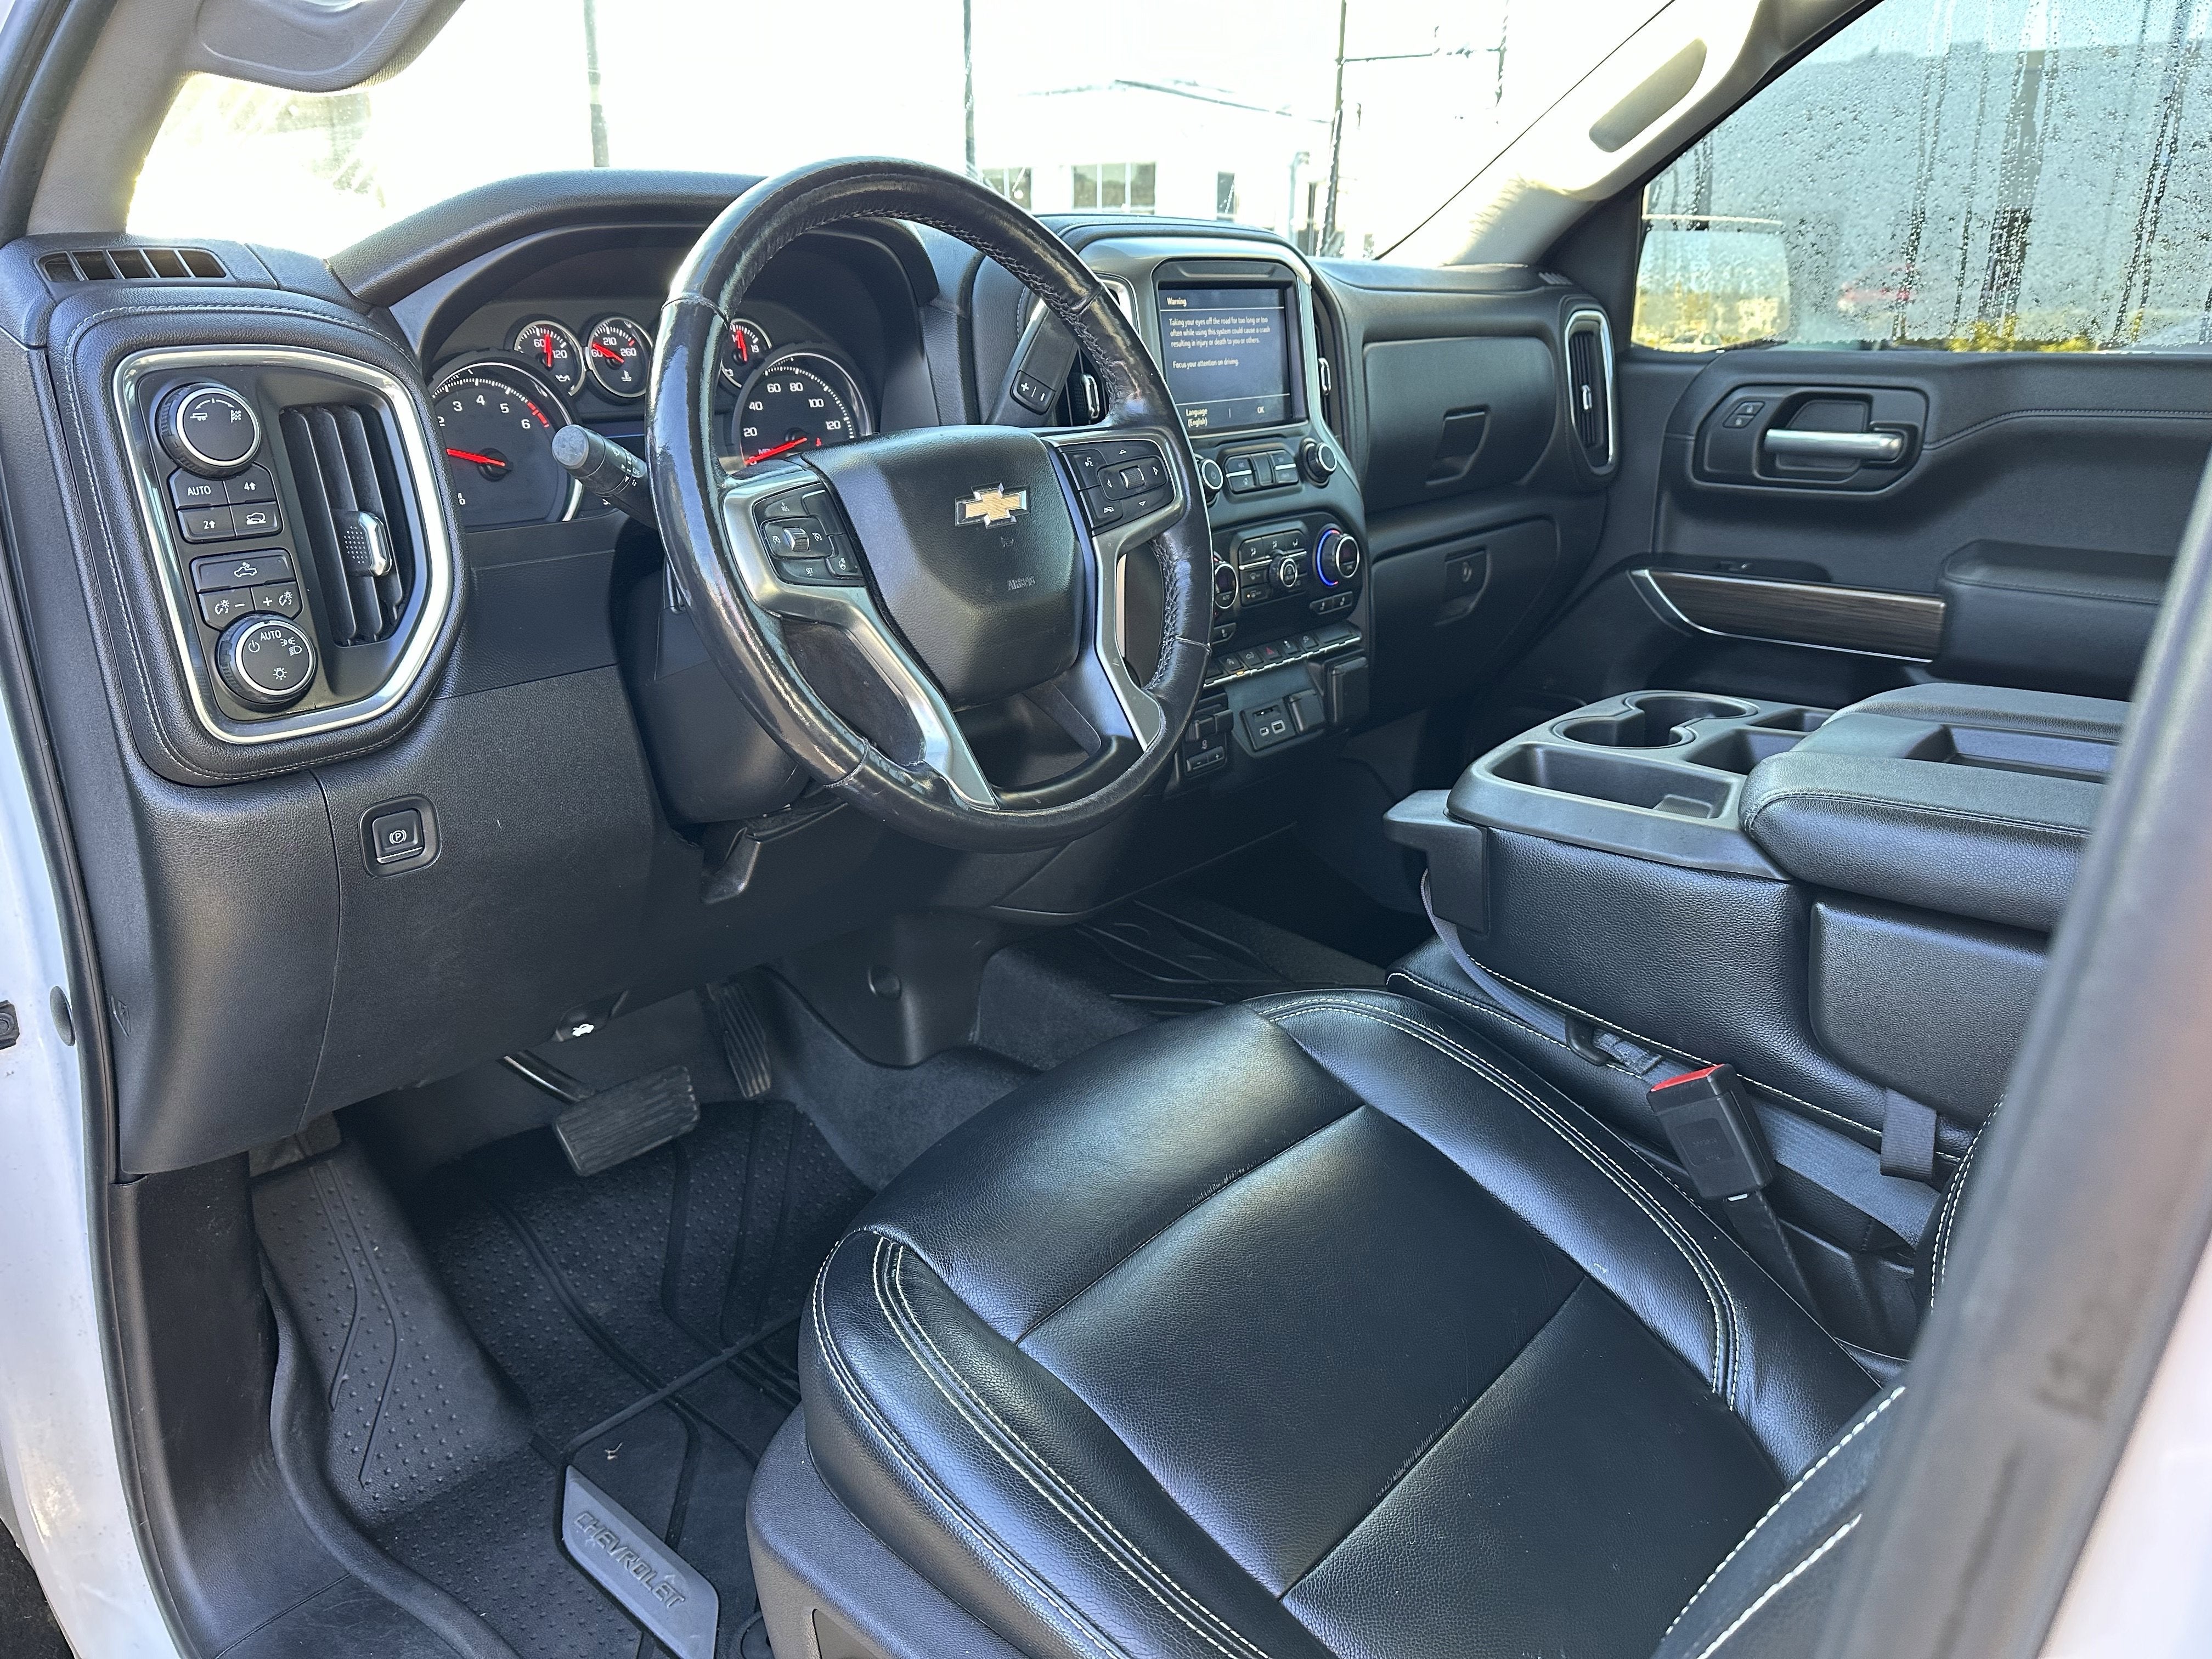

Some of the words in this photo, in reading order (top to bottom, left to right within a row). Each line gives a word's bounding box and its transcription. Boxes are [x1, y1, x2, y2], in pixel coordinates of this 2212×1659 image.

[1166, 297, 1187, 307] Warning
[1169, 318, 1184, 328] Taking
[1246, 316, 1255, 325] long
[1170, 329, 1182, 337] often
[1195, 328, 1207, 337] using
[1216, 328, 1231, 337] system
[533, 339, 545, 348] 60
[603, 337, 617, 346] 210
[1171, 339, 1191, 348] resulting
[1196, 339, 1208, 348] injury
[1245, 336, 1260, 344] others.
[552, 349, 568, 358] 120
[620, 348, 637, 357] 260
[751, 345, 759, 353] 19
[1173, 360, 1187, 369] Focus
[1187, 362, 1197, 370] your
[766, 383, 781, 393] 60
[789, 382, 804, 392] 80
[476, 394, 486, 405] 4
[808, 398, 824, 408] 100
[453, 401, 462, 411] 3
[500, 403, 509, 413] 5
[749, 401, 763, 411] 40
[1186, 409, 1208, 417] Language
[521, 419, 531, 429] 6
[825, 420, 841, 430] 120
[1188, 417, 1207, 428] (English)
[743, 427, 758, 437] 20
[187, 486, 211, 496] AUTO
[260, 630, 281, 641] AUTO
[574, 1511, 685, 1609] CHEVROLET
